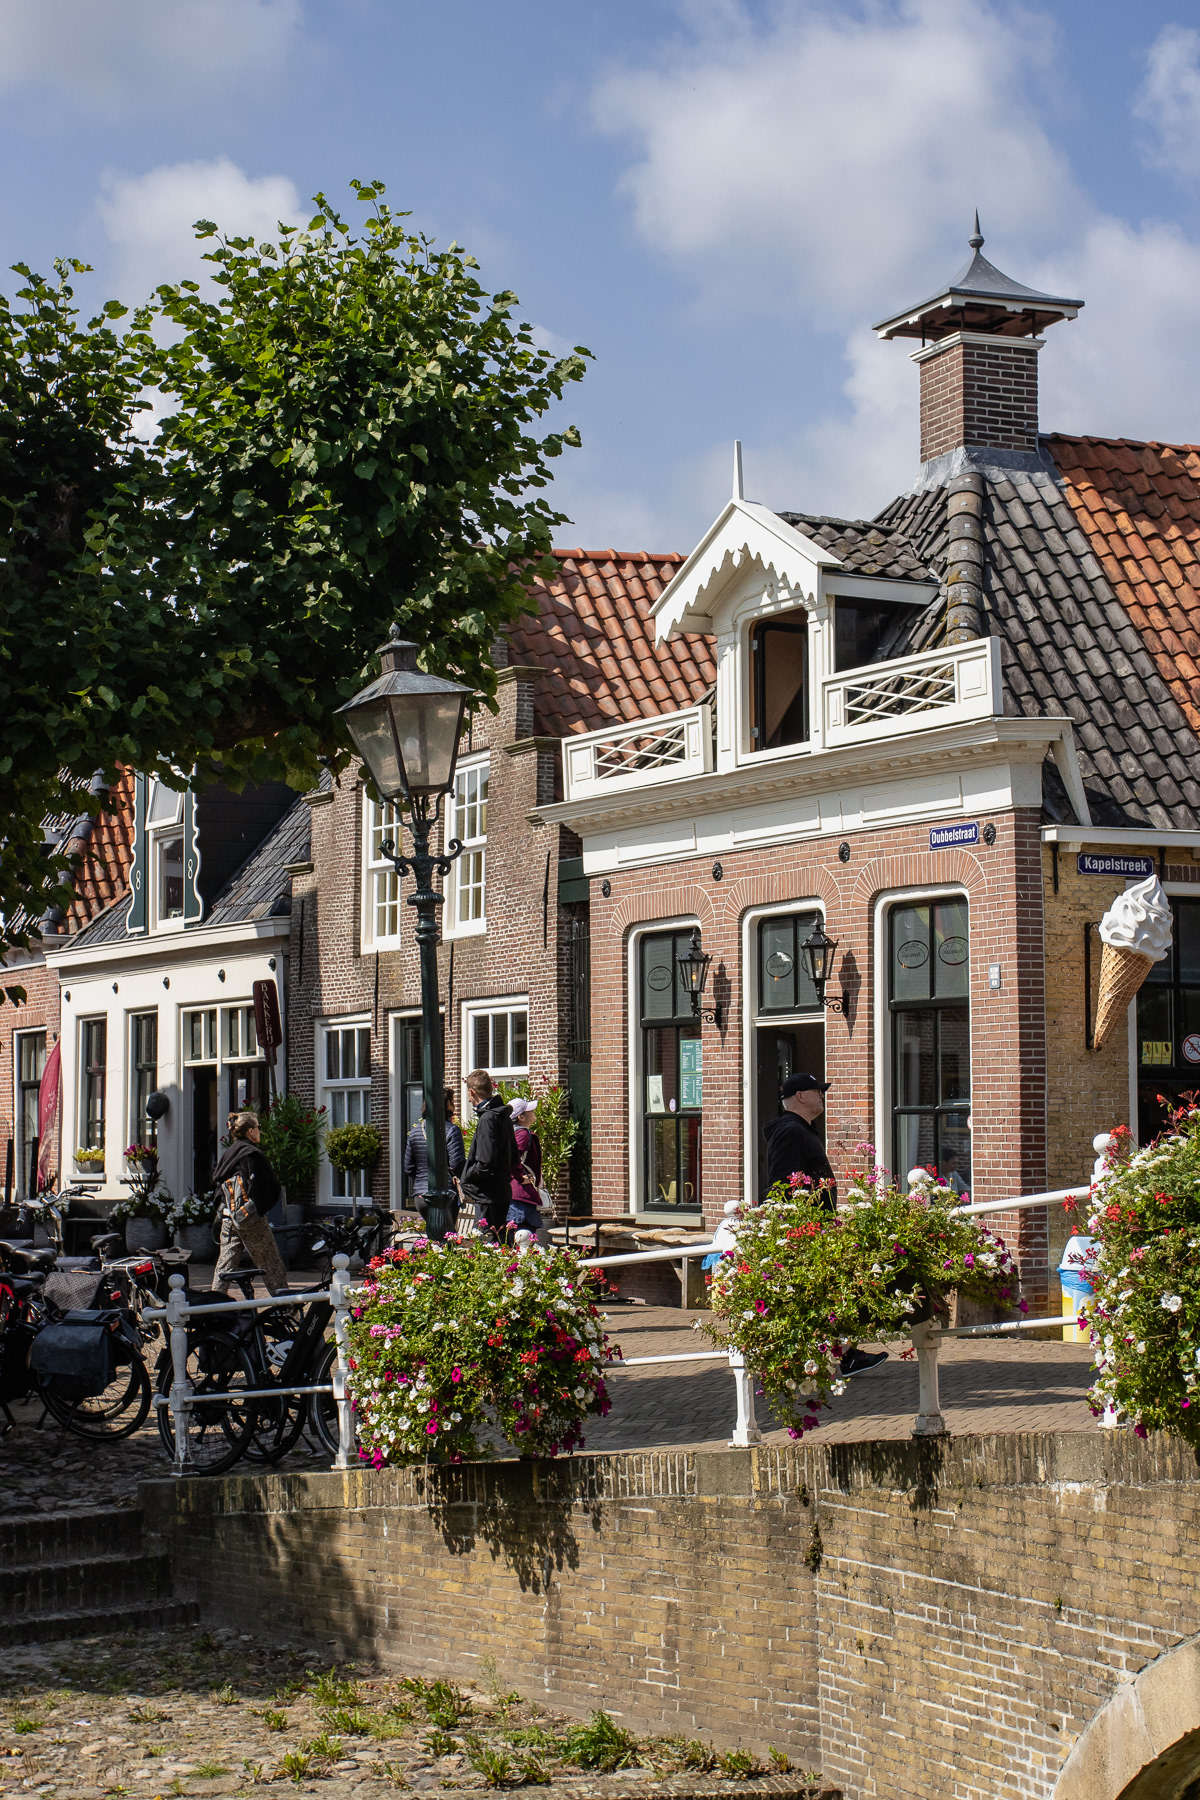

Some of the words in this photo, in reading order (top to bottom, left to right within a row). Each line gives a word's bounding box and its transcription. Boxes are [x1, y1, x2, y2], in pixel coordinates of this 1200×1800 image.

[931, 826, 976, 845] Dubbelstraat
[1084, 856, 1147, 873] Kapelstreek
[260, 982, 274, 1045] BAKKERIJ
